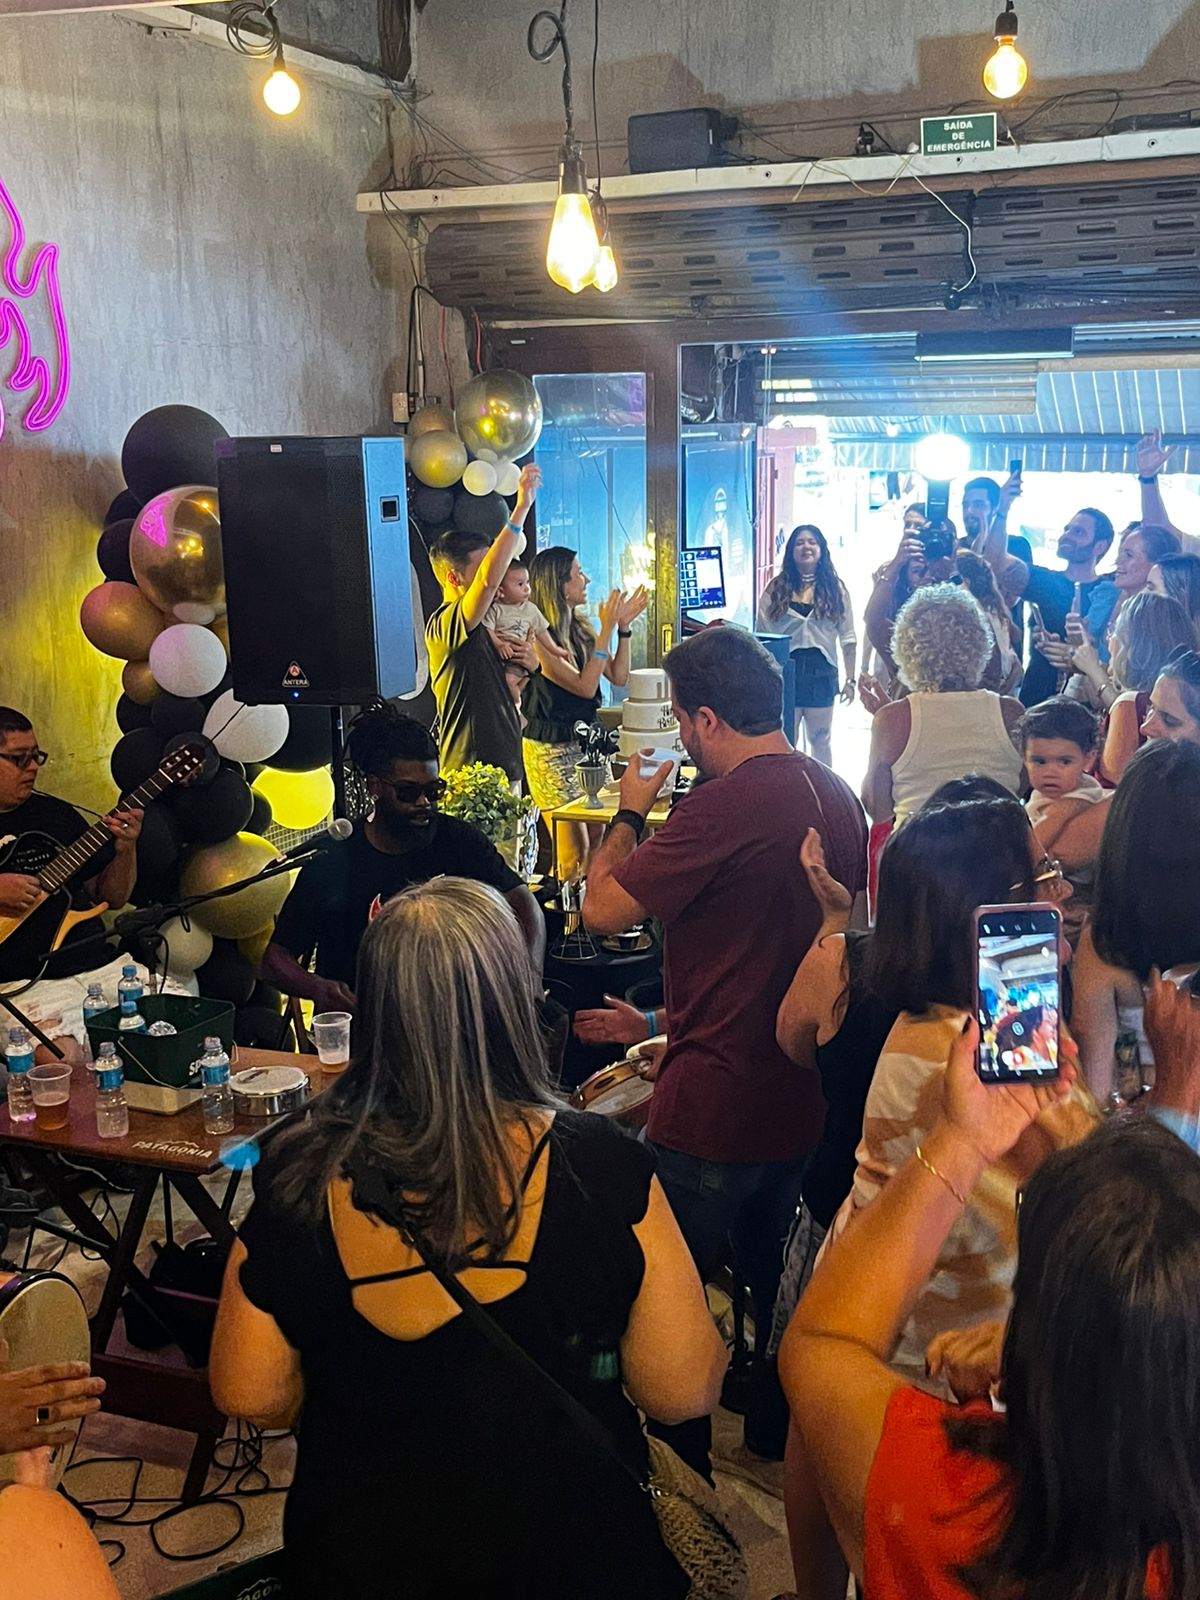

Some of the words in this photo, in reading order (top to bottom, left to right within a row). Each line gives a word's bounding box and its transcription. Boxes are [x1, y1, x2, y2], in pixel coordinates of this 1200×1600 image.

[944, 120, 973, 131] SAÍDA
[952, 132, 965, 140] DE
[927, 140, 991, 152] EMERGÊNCIA
[132, 1141, 213, 1158] PATAGONIA
